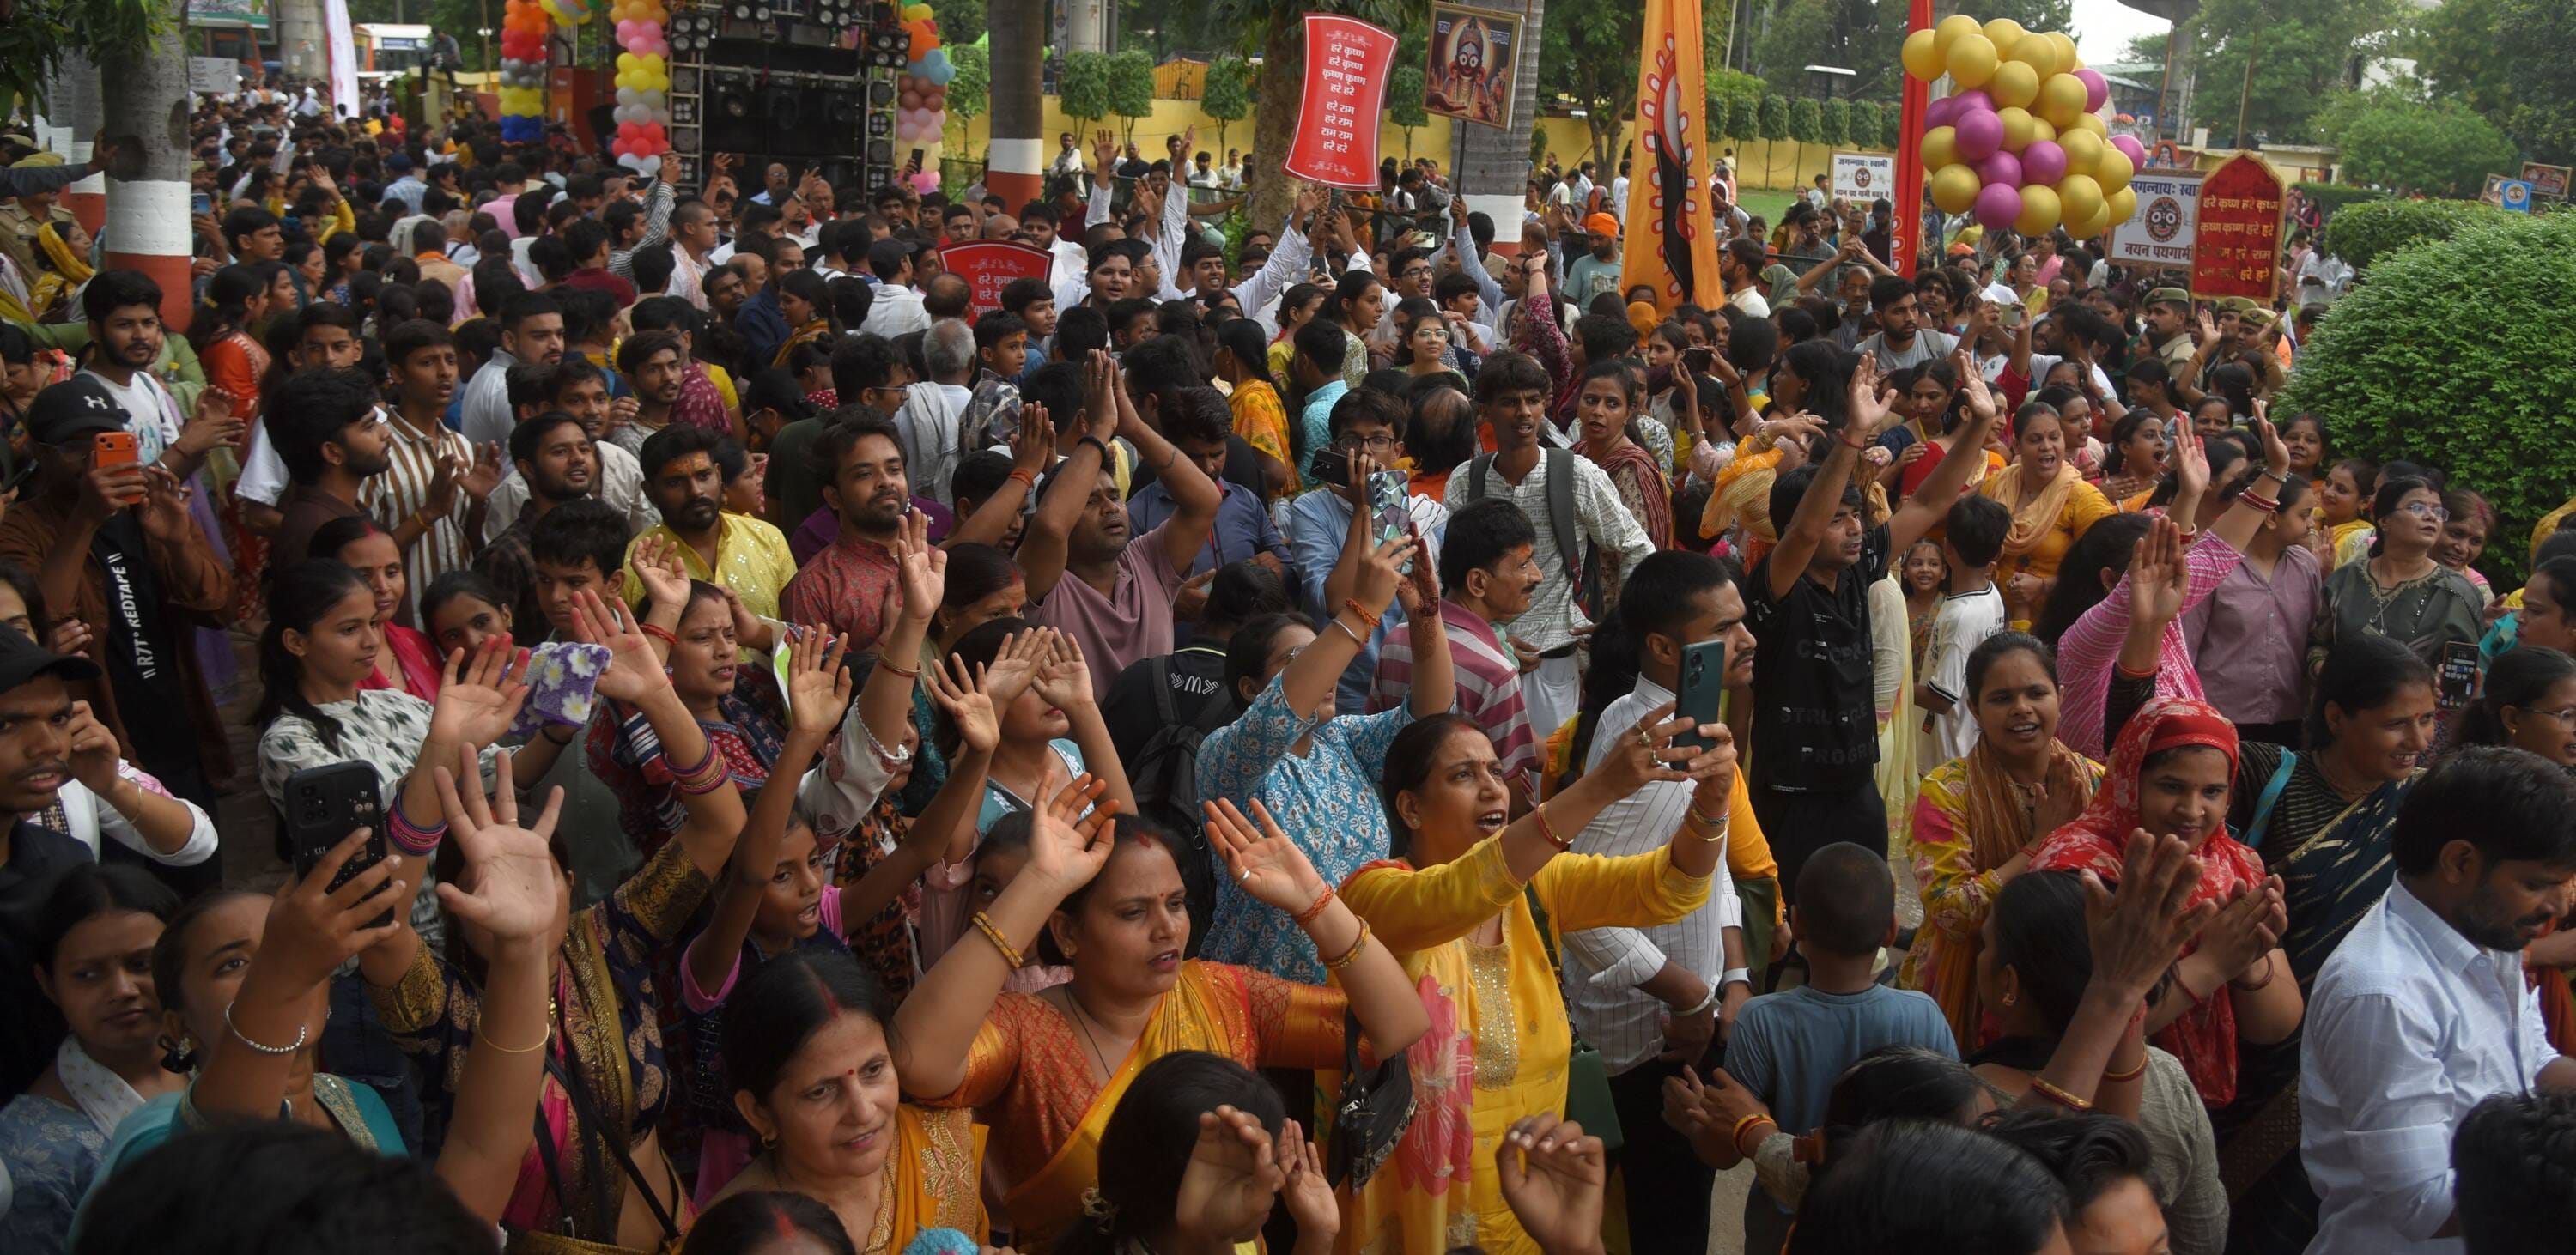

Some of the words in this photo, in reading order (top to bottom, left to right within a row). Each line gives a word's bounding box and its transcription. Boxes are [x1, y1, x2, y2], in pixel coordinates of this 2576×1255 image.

[1331, 42, 1342, 53] हरे
[1344, 46, 1364, 58] कृष्ण
[1328, 56, 1340, 66] हरे
[1342, 59, 1364, 71] कृष्ण
[1322, 69, 1344, 81] कृष्ण
[1346, 73, 1367, 85] कृष्ण
[1330, 82, 1341, 94] हरे
[1344, 85, 1355, 96] हरे
[1326, 100, 1338, 112] हरे
[1340, 104, 1355, 114] राम
[1324, 113, 1336, 124] हरे
[1338, 117, 1353, 128] राम
[1321, 126, 1336, 137] राम
[1338, 130, 1353, 141] राम
[1323, 140, 1335, 150] हरे
[1336, 142, 1348, 153] हरे
[2202, 194, 2216, 208] हरे
[2218, 197, 2240, 212] कृष्ण
[2200, 221, 2221, 235] कृष्ण
[2222, 222, 2245, 236] कृष्ण
[2246, 221, 2260, 235] हरे
[2262, 222, 2275, 237] हरे
[2124, 243, 2150, 257] नयन
[2252, 249, 2272, 260] राम
[978, 272, 992, 285] हरे
[2240, 266, 2253, 282] हरे
[979, 288, 992, 300] हरे
[112, 566, 142, 628] REDTAPE
